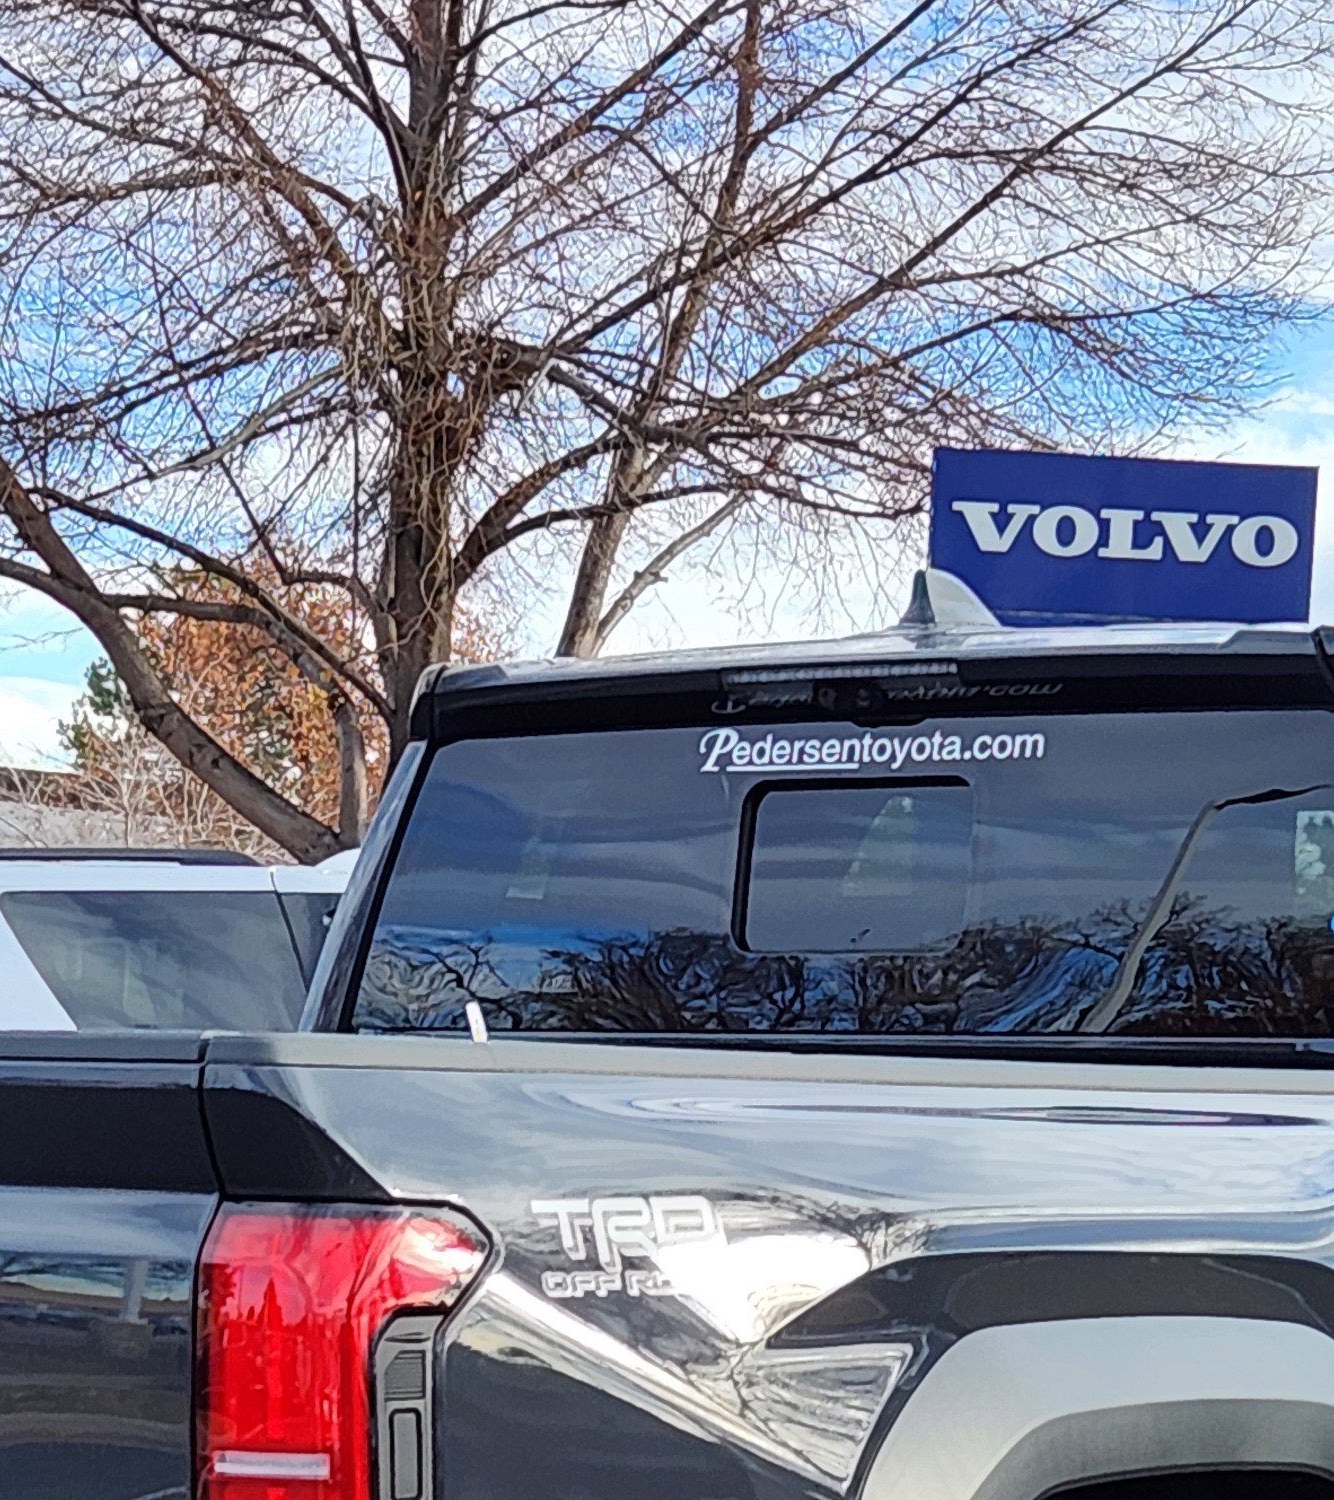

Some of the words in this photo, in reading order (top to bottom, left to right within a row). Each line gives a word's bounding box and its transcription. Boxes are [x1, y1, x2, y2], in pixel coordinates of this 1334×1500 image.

[952, 500, 1299, 568] VOLVO
[698, 726, 1046, 773] Pedersentoyota.com
[530, 1195, 715, 1274] TRD
[541, 1270, 622, 1298] OFF
